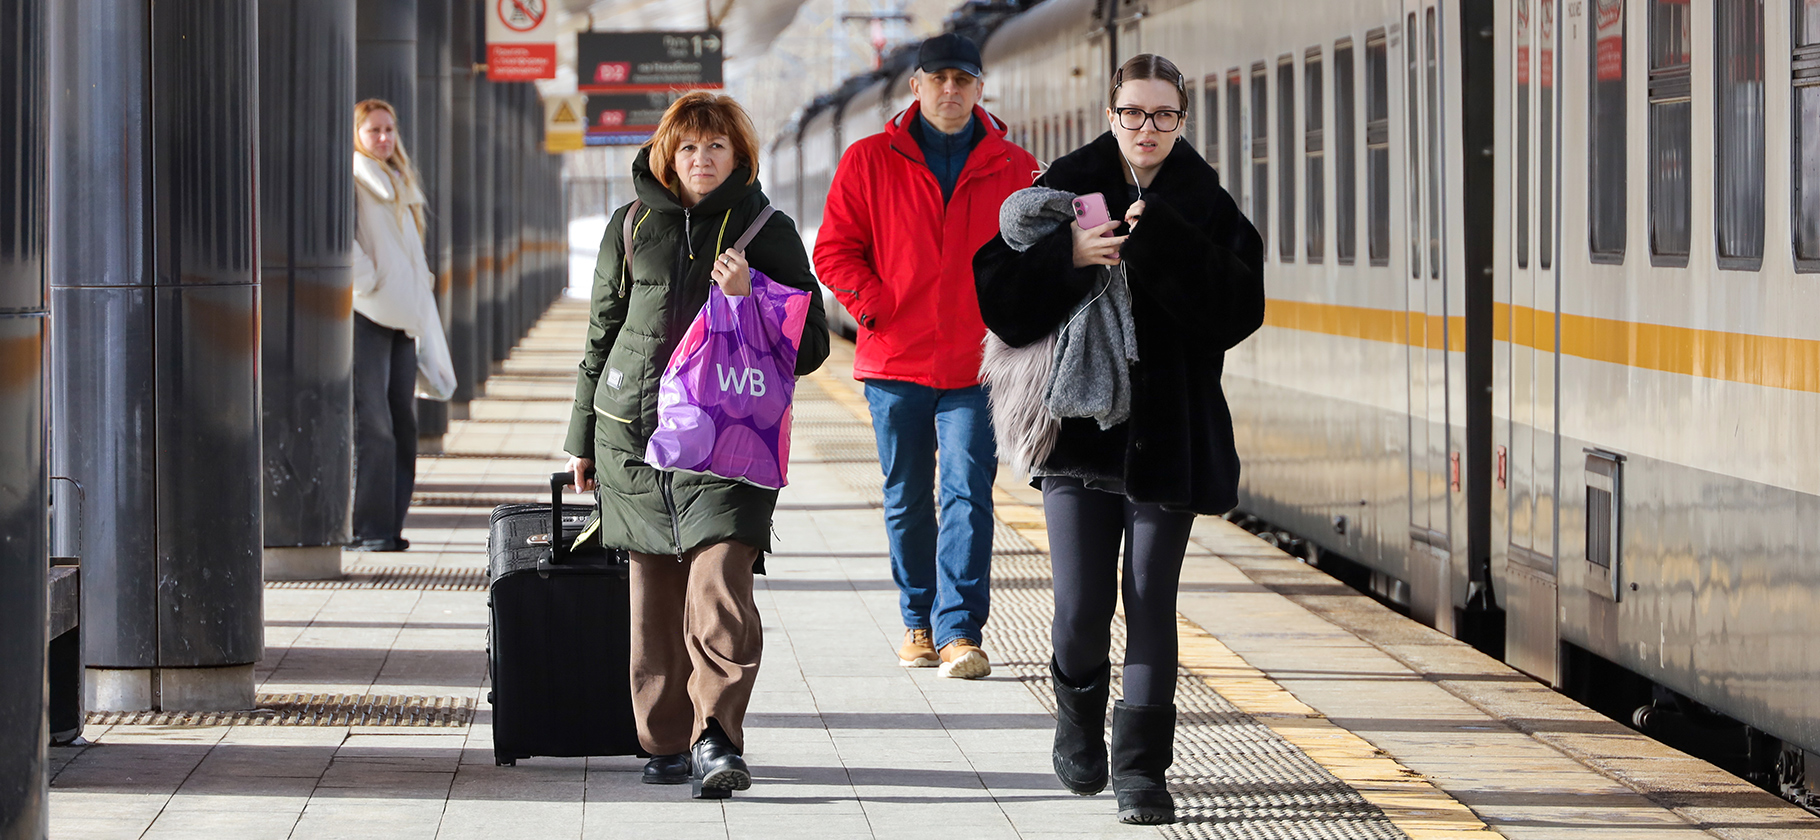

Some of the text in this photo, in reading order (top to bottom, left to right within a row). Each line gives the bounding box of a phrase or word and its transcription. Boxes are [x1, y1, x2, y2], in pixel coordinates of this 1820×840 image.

[690, 35, 703, 58] 1
[600, 64, 625, 82] D2
[716, 363, 766, 397] WB
